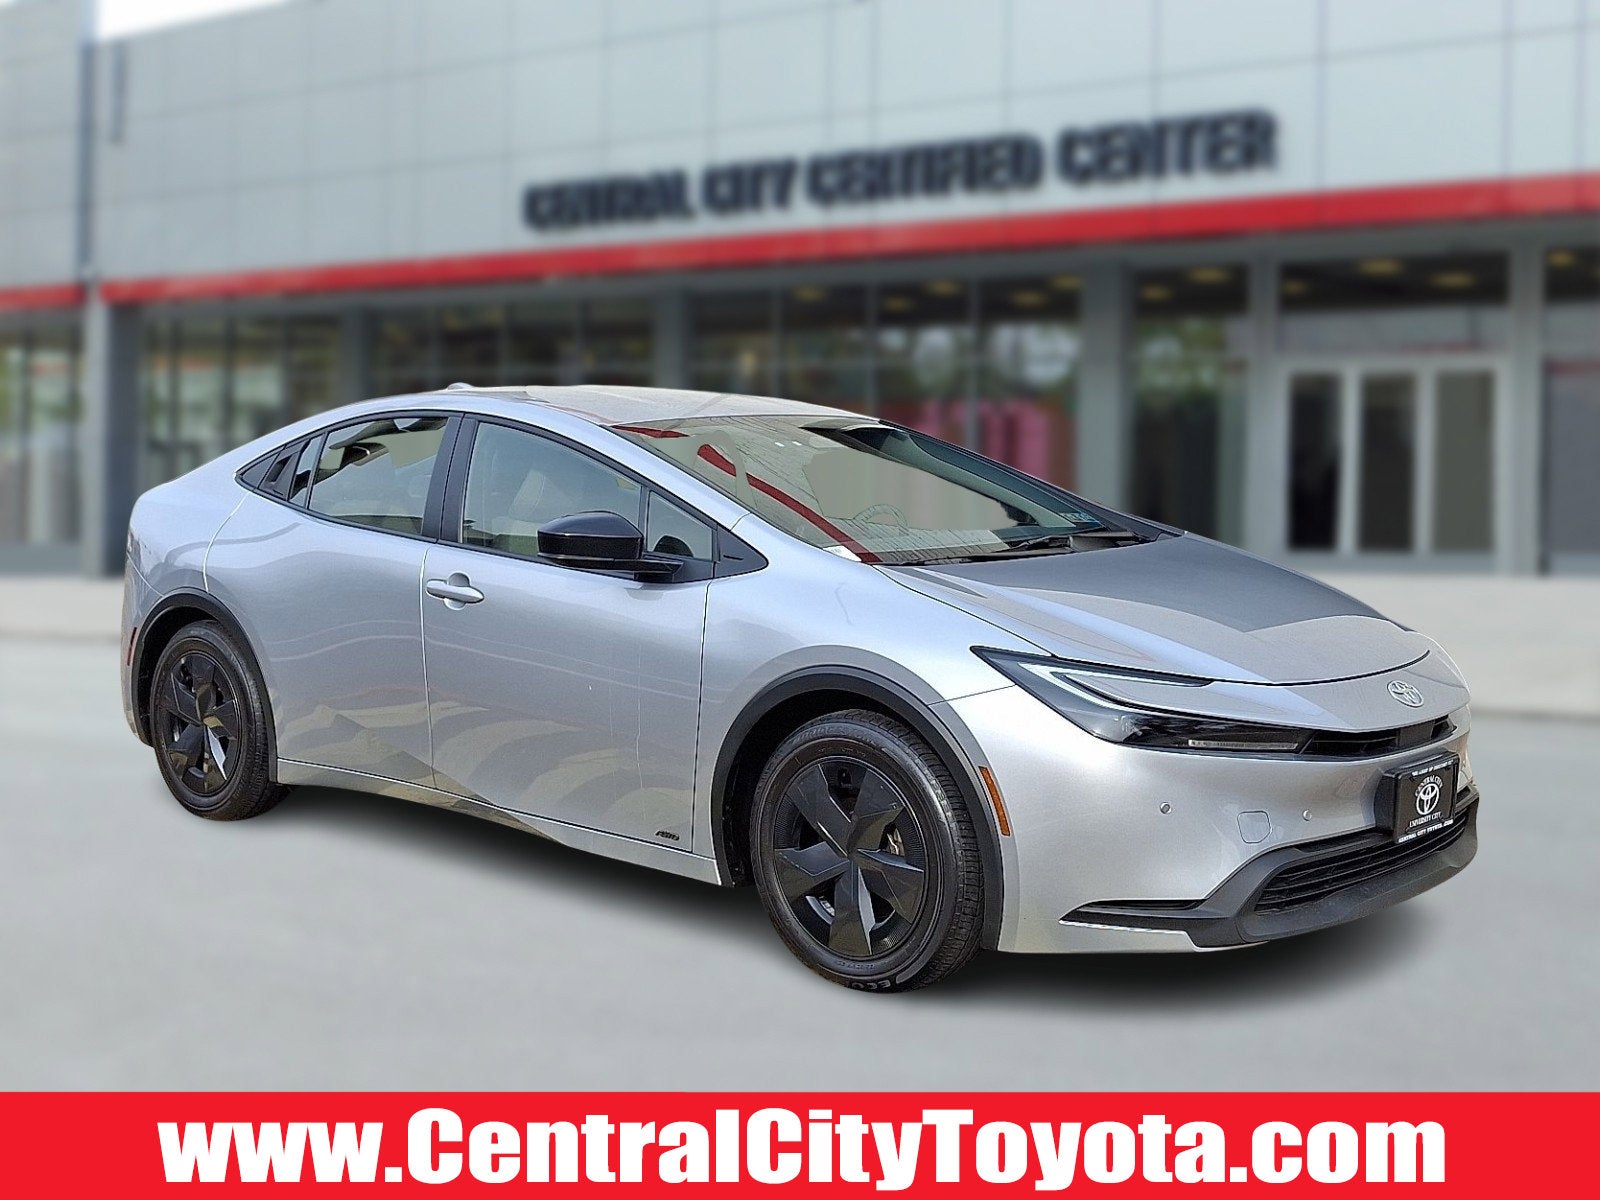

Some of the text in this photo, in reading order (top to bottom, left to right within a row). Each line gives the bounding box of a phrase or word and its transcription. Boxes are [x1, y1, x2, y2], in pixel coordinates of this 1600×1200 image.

[523, 107, 1277, 232] CENTRAL CITY CERTIFIED CENTER
